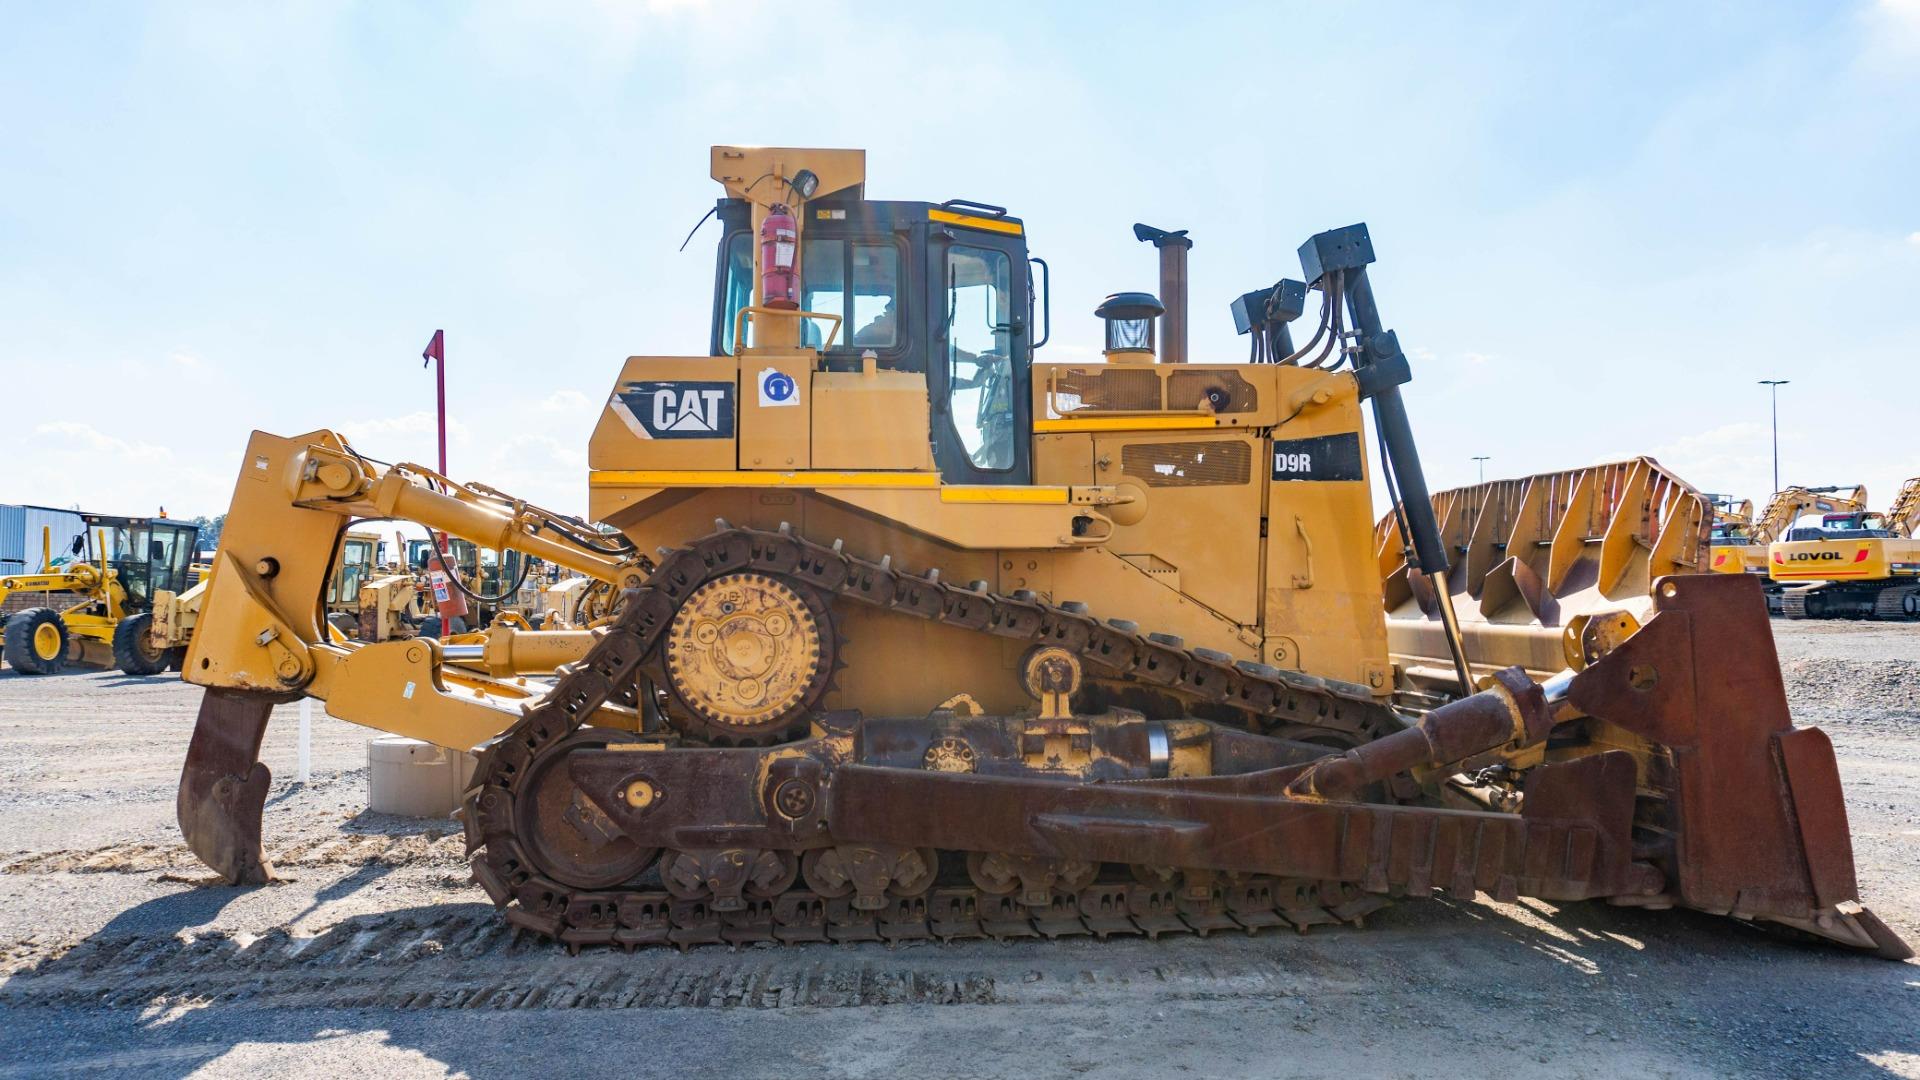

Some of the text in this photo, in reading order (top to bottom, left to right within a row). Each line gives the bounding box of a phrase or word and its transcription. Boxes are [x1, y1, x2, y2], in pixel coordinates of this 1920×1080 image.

[653, 389, 725, 431] CAT
[1275, 453, 1311, 472] D9R
[1790, 552, 1843, 561] LOVOL
